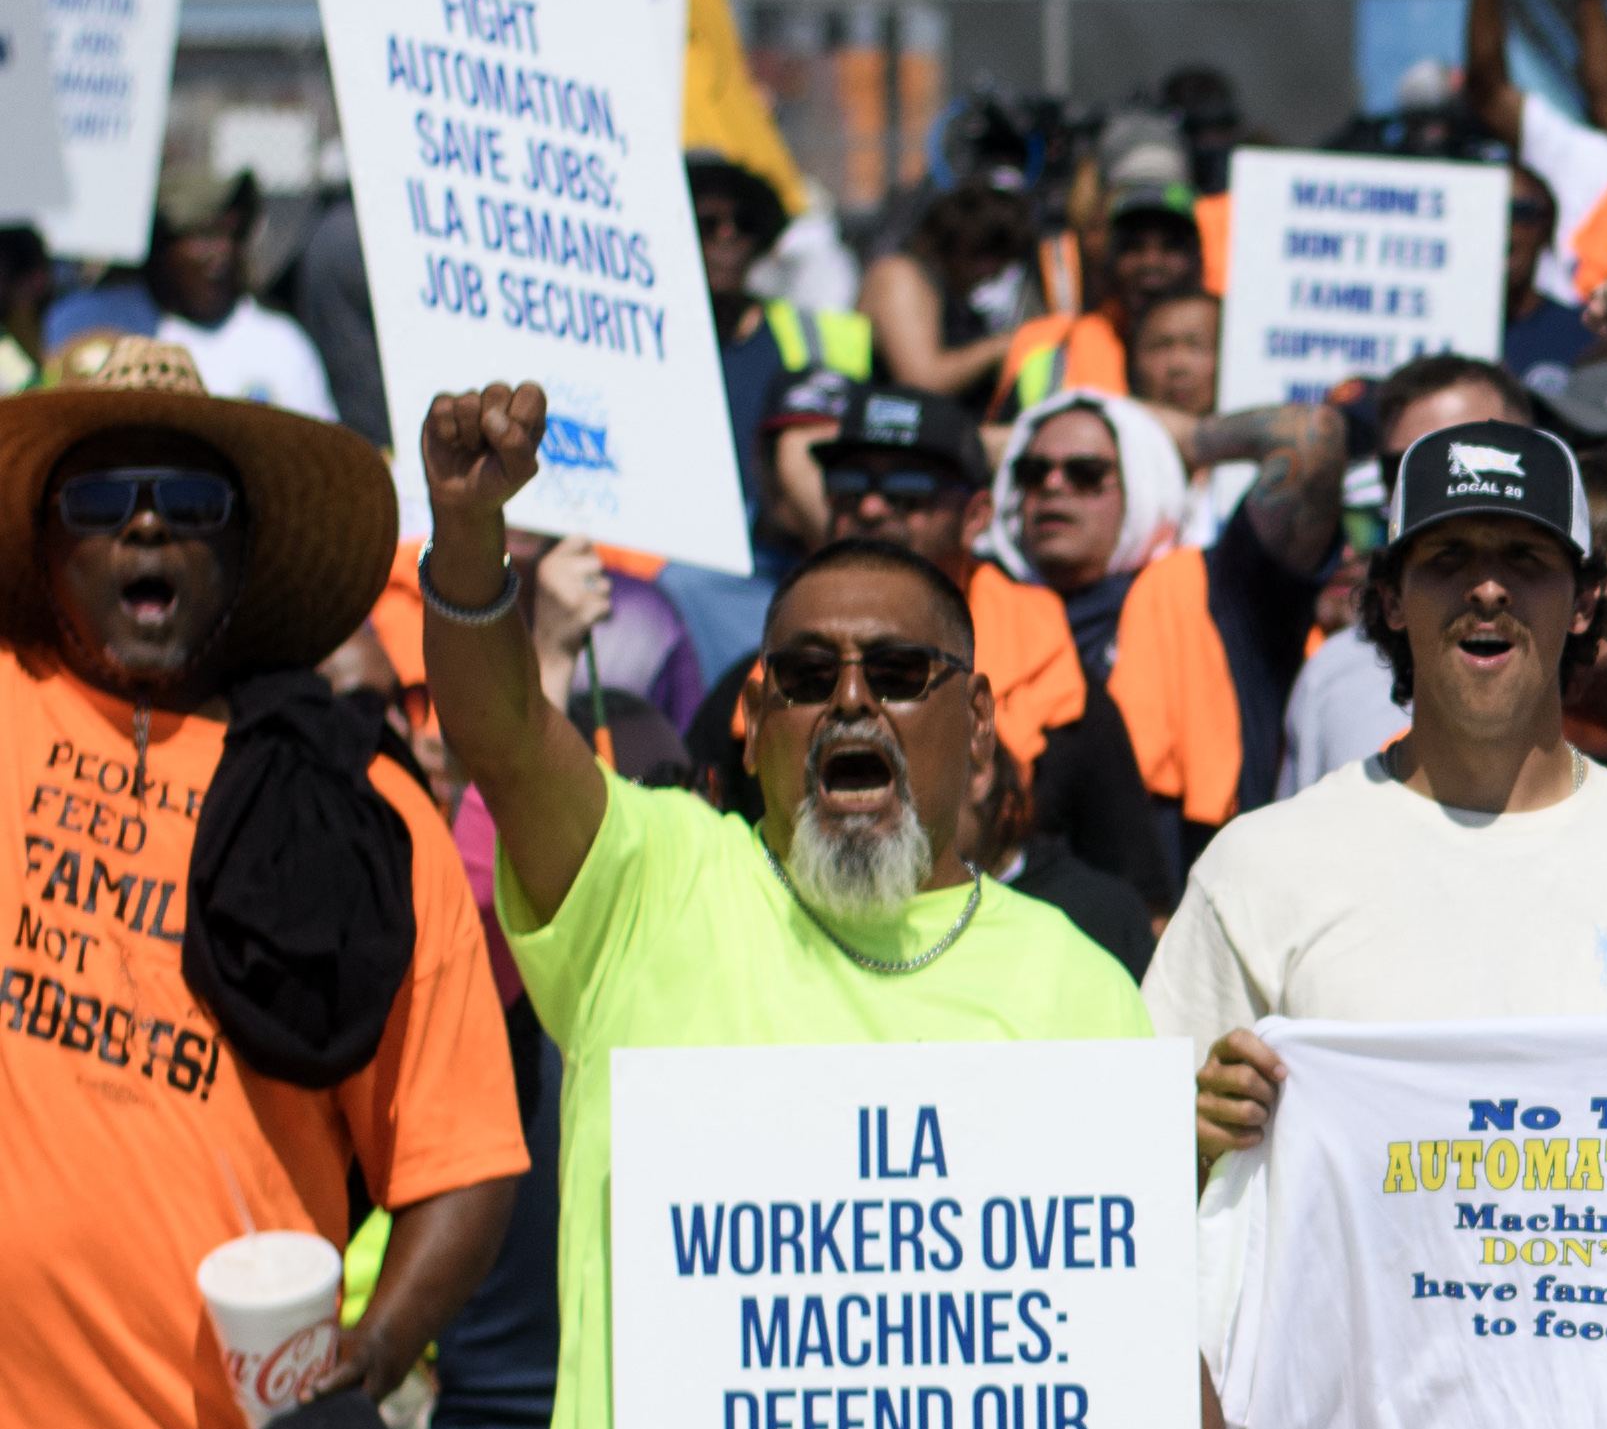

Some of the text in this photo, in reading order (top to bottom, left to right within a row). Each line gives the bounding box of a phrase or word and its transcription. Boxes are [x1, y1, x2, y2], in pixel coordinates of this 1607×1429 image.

[387, 34, 629, 157] AUTOMATION,
[415, 111, 623, 213] SAVE JOBS:
[407, 178, 656, 289] ILA DEMANDS
[1291, 180, 1446, 219] MACHINES
[1284, 230, 1447, 271] DON'T FEED
[420, 253, 666, 362] JOB SECURITY
[1264, 326, 1398, 366] SUPPORT
[1446, 482, 1524, 501] LOCAL 20
[28, 783, 148, 855] FEED
[24, 833, 186, 944] FAMIL
[14, 902, 100, 974] NOT
[0, 966, 221, 1103] ROBOTS!
[857, 1104, 949, 1181] ILA
[1468, 1098, 1562, 1132] No
[669, 1194, 1137, 1278] WORKERS OVER
[1411, 1270, 1518, 1302] have
[740, 1289, 1070, 1370] MACHINES:
[1472, 1312, 1518, 1338] to
